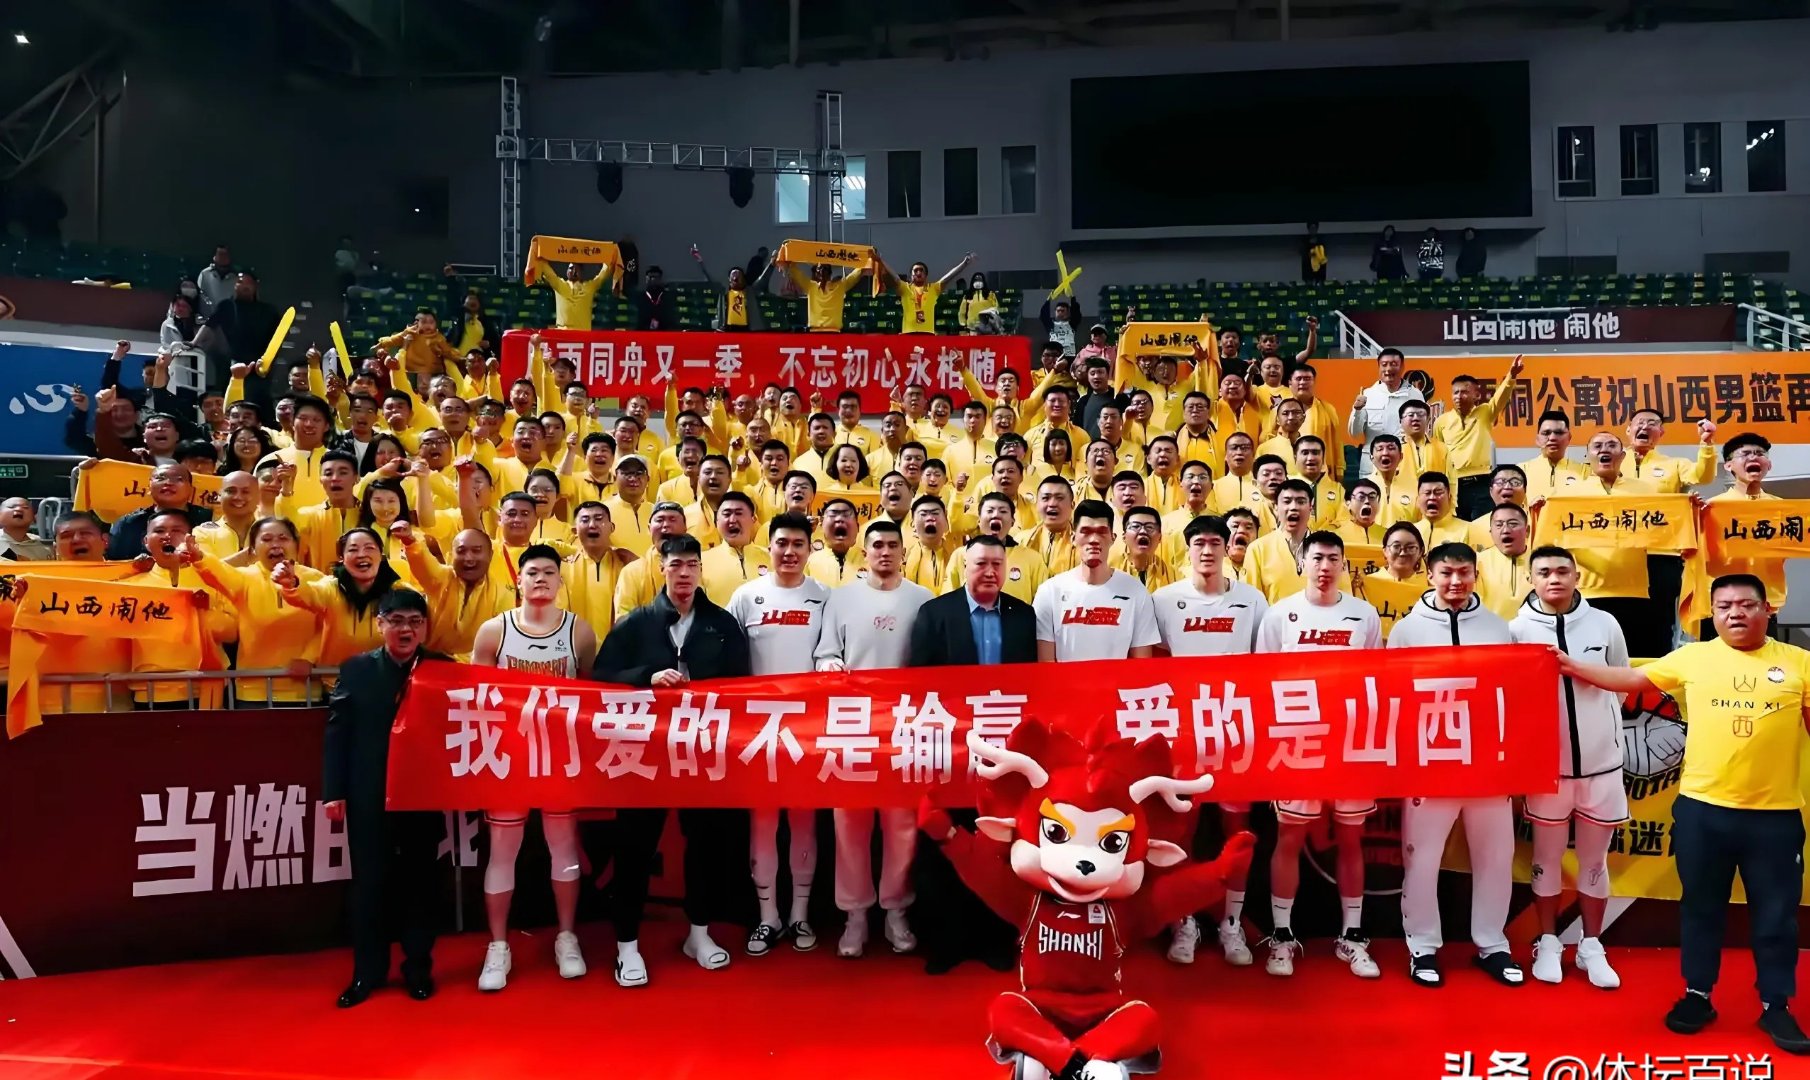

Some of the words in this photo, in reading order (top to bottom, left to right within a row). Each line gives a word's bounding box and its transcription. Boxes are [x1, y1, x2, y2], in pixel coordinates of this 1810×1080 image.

[1561, 509, 1669, 533] 山西闹他
[1724, 515, 1810, 543] 山西闹
[40, 591, 173, 624] 山西闹他
[1711, 698, 1755, 709] SHAN
[1038, 921, 1103, 961] SHANXI
